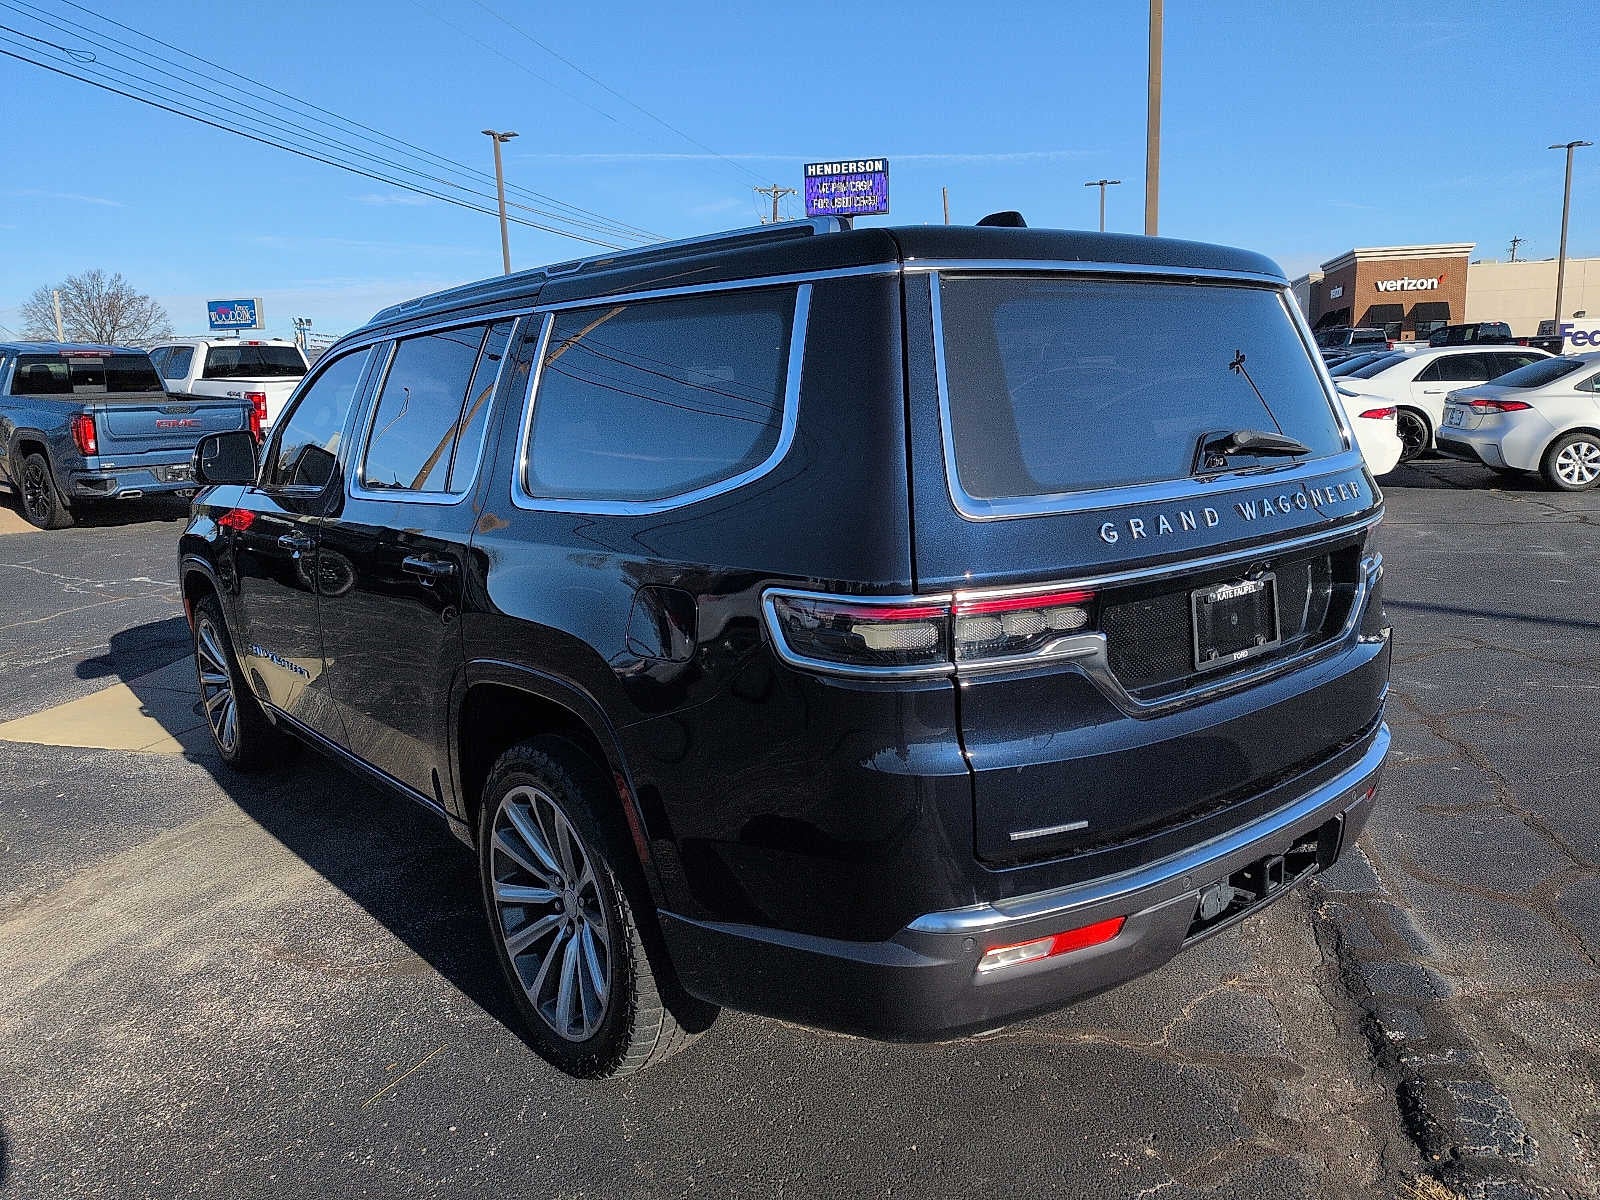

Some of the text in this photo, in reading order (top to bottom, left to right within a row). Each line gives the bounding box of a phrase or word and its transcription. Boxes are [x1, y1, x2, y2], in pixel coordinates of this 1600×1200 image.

[808, 160, 883, 175] HENDERSON
[813, 198, 830, 209] FOR
[1375, 277, 1438, 291] verizon
[156, 419, 201, 428] GMC
[1100, 481, 1361, 543] GRAND WAGONEER
[1233, 650, 1248, 661] FORD
